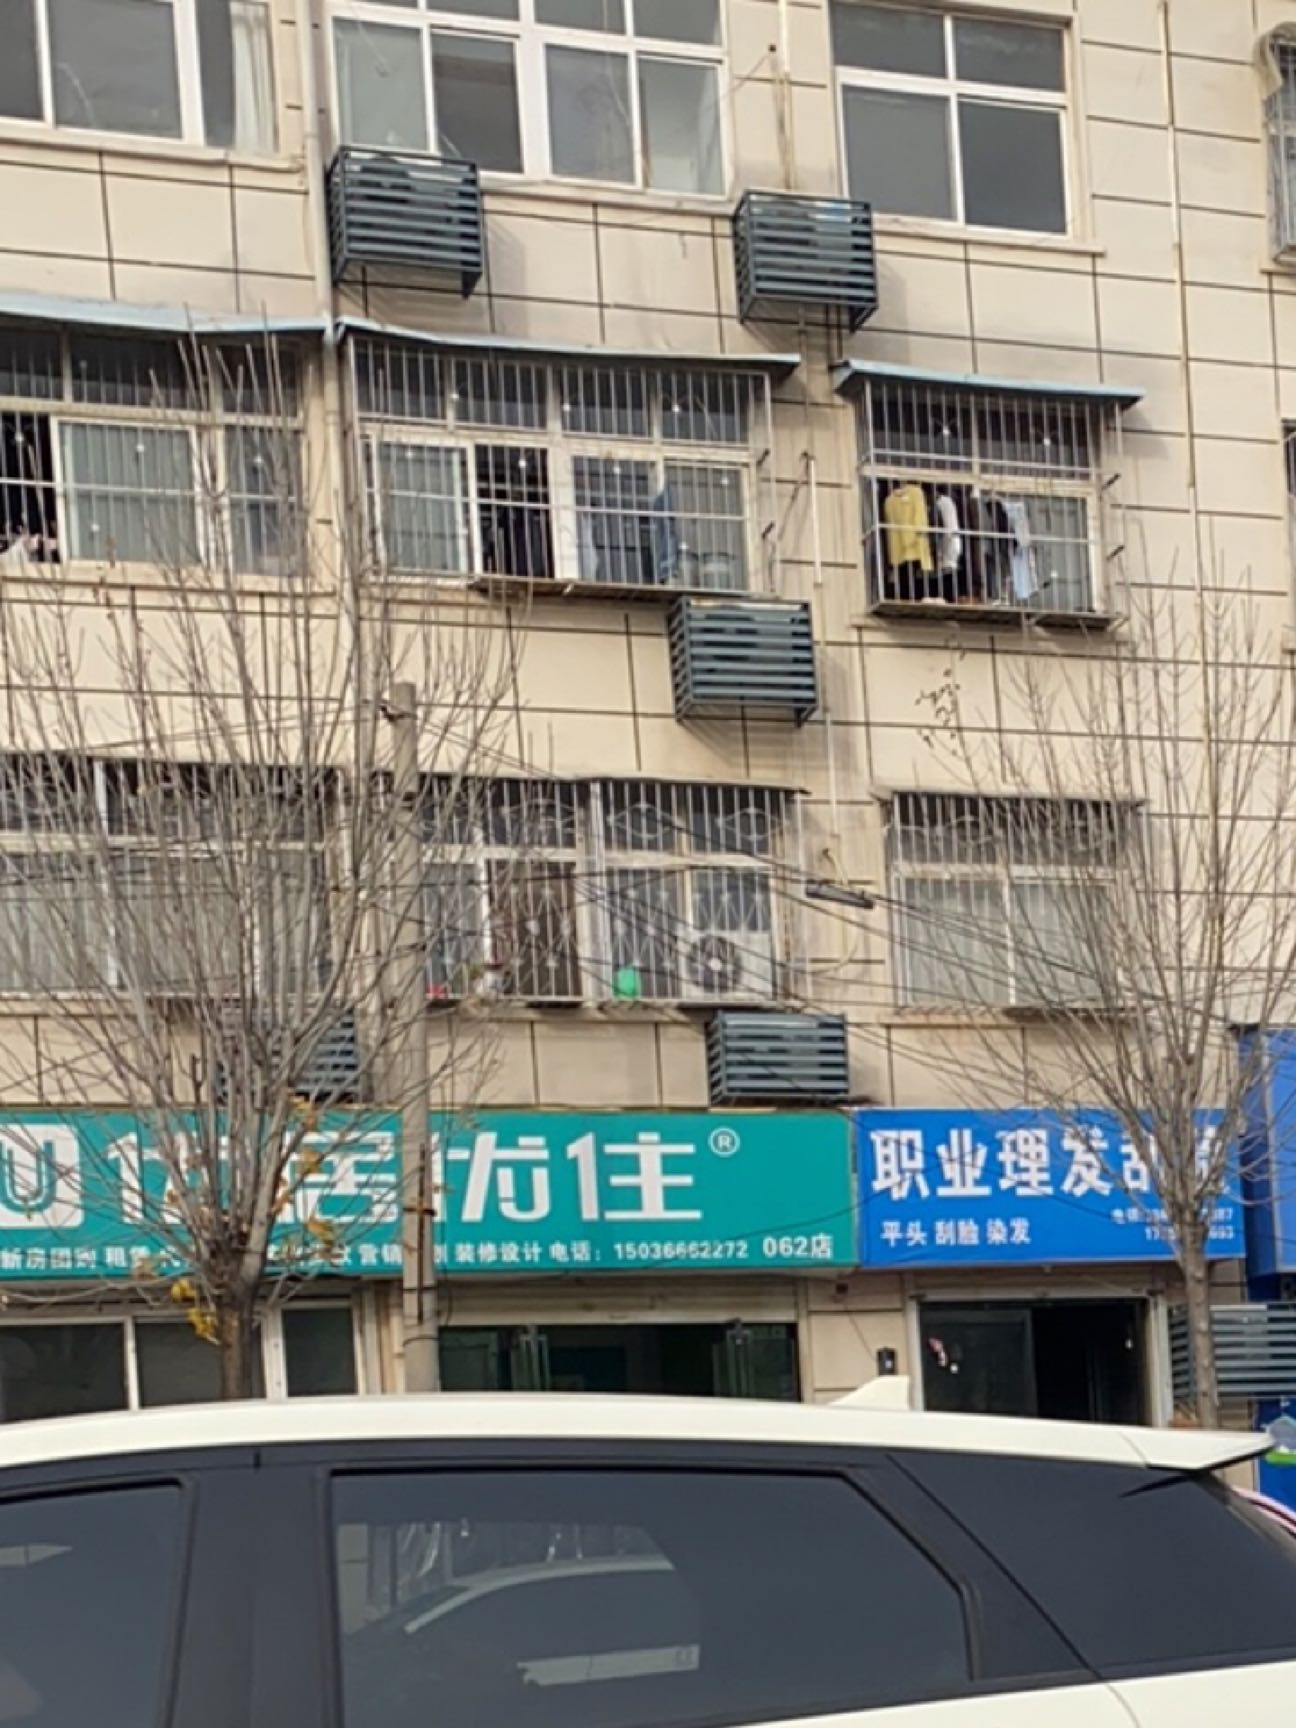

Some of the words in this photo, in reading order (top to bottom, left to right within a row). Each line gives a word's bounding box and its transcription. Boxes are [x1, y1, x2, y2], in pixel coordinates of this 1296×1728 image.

[870, 1127, 1231, 1200] 职业理发刮
[762, 1232, 834, 1260] 062店
[881, 1220, 927, 1247] 平头
